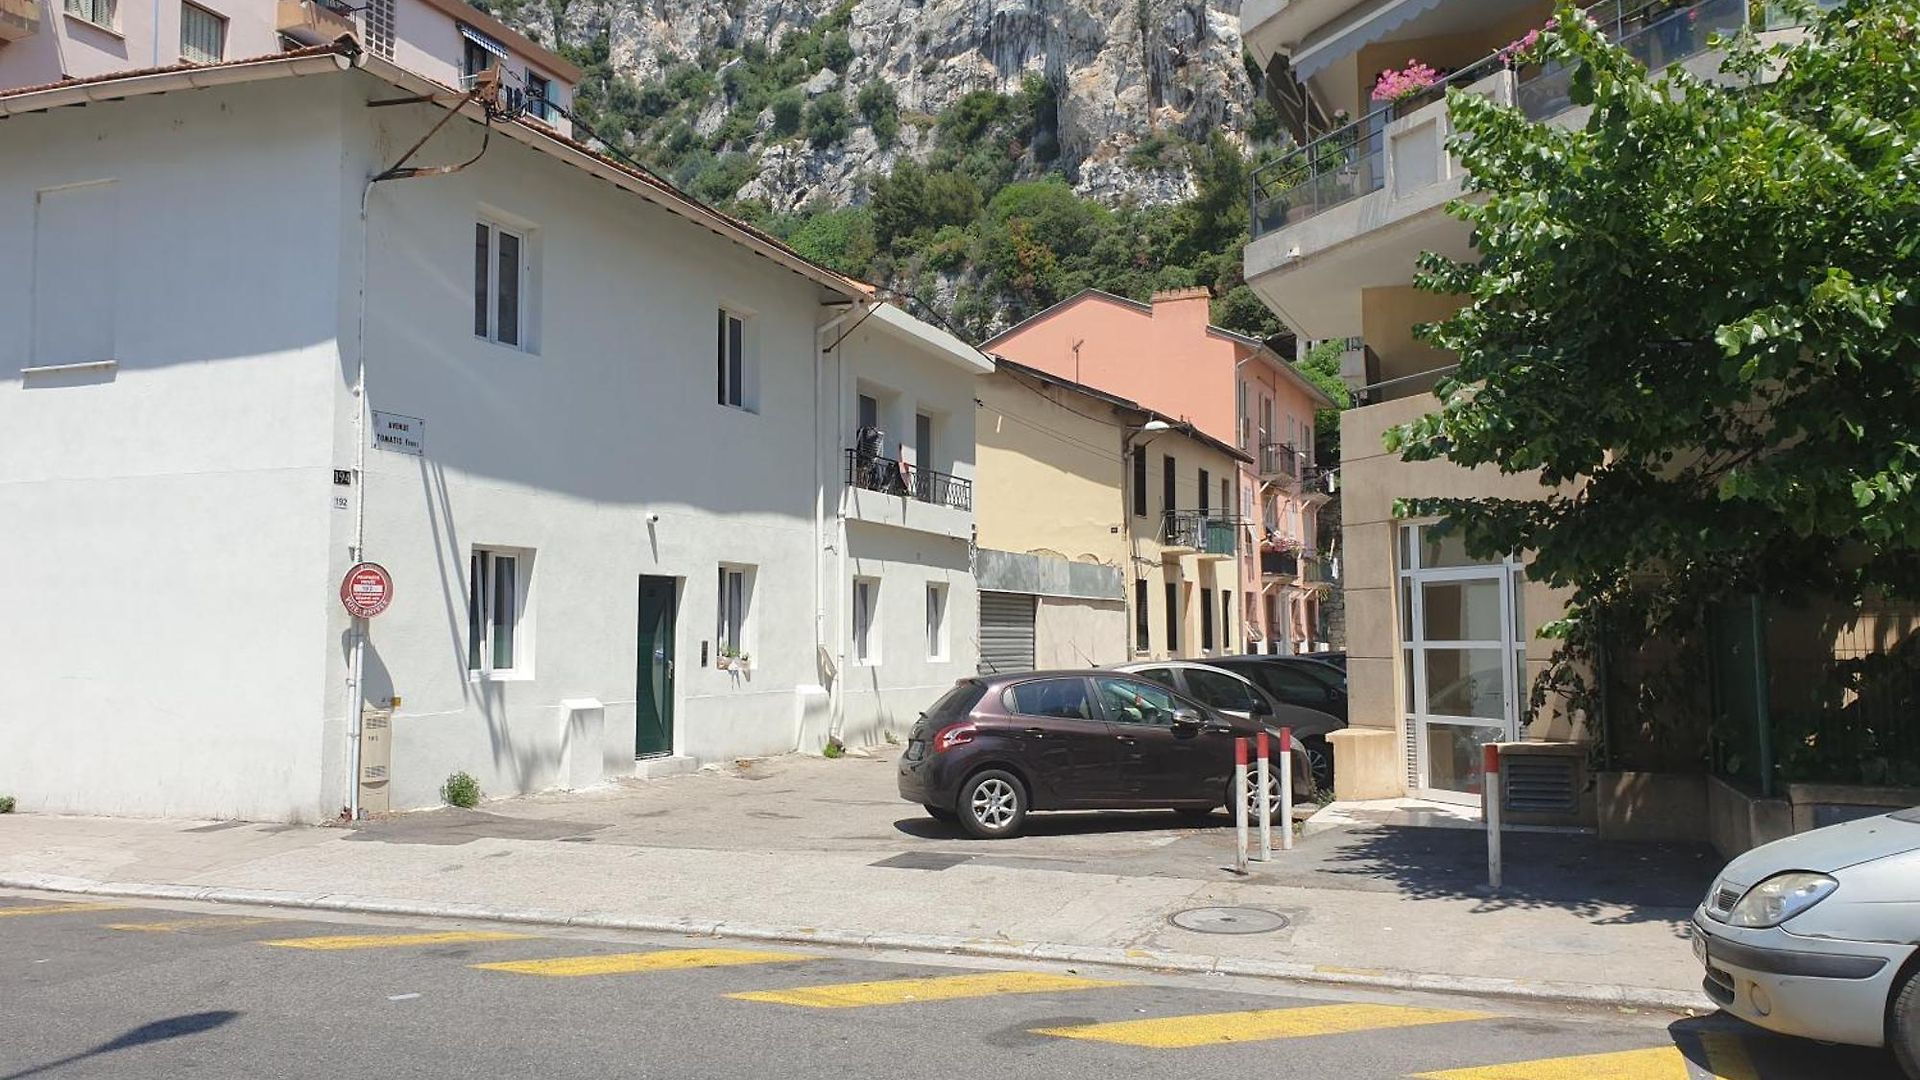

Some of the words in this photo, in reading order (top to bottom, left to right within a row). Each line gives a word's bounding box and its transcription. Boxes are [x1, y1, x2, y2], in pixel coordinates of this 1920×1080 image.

[388, 421, 409, 431] AVENUE
[335, 471, 350, 483] 194
[335, 497, 348, 506] 192
